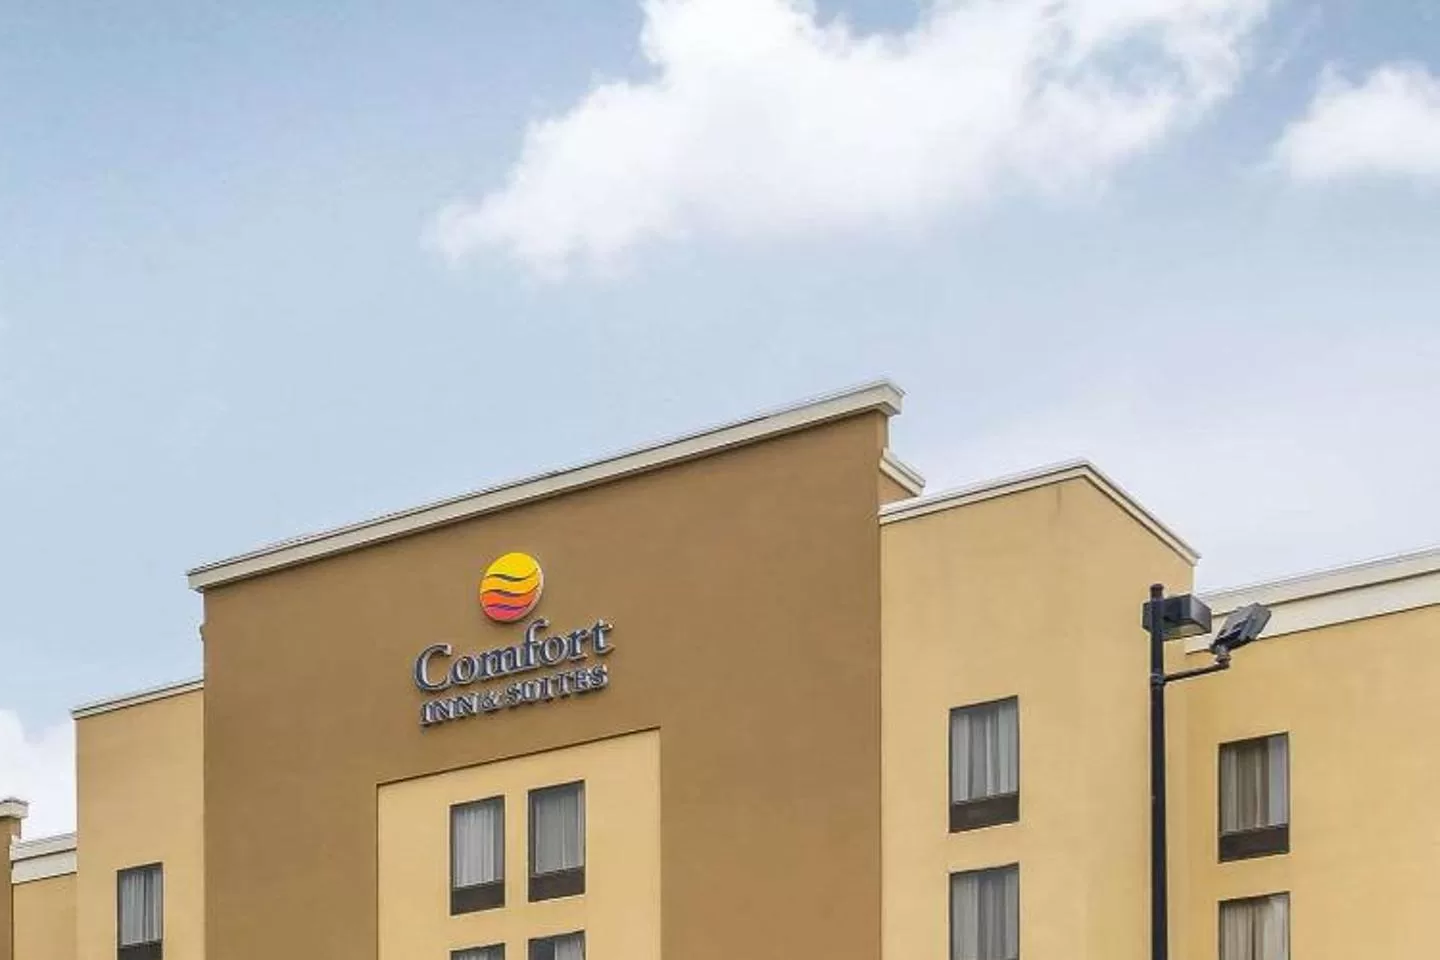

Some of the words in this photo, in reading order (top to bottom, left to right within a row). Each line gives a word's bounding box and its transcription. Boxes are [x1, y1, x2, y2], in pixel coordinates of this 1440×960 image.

[415, 616, 615, 692] Comfort
[419, 693, 479, 725] INN
[481, 690, 503, 713] &
[506, 663, 609, 704] SUITES
